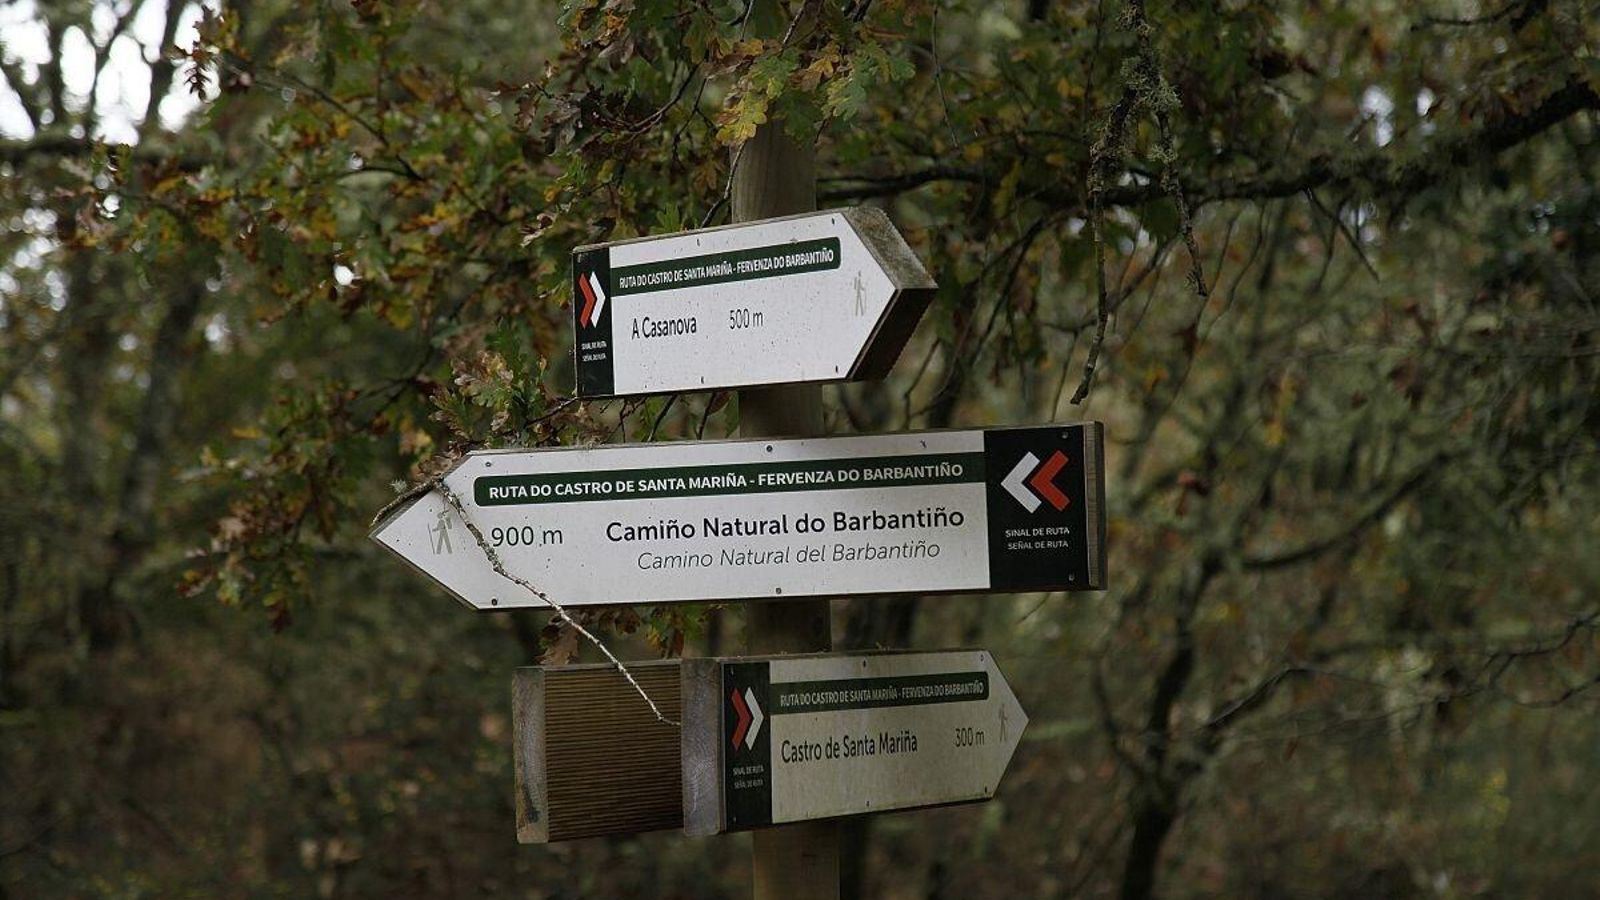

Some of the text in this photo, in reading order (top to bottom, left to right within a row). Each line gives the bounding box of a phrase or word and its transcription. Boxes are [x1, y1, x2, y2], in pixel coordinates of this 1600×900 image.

[619, 276, 637, 289] RUTA
[637, 272, 647, 286] DO
[647, 270, 673, 285] CASTRO
[674, 266, 683, 281] DE
[683, 264, 705, 280] SANTA
[706, 261, 732, 277] MARIÑA
[736, 258, 773, 273] FERVENZA
[773, 254, 785, 269] DO
[785, 247, 833, 267] BARBANTIÑO
[631, 316, 697, 339] A Casanova
[729, 309, 764, 329] 500 m
[489, 485, 528, 499] RUTA
[530, 484, 552, 497] DO
[554, 480, 612, 496] CASTRO
[615, 478, 635, 493] DE
[637, 477, 686, 492] SANTA
[688, 472, 748, 489] MARIÑA
[758, 471, 835, 486] FERVENZA
[837, 469, 860, 482] DO
[863, 462, 964, 481] BARBANTIÑO
[491, 526, 564, 547] 900 m
[606, 507, 966, 542] Camiño Natural do Barbantiño
[1005, 527, 1070, 538] SINAL DE RUTA
[637, 540, 941, 570] Camino Natural del Barbantiño
[1034, 541, 1046, 549] DE
[1047, 540, 1069, 549] RUTA
[780, 693, 799, 707] RUTA
[800, 692, 811, 705] DO
[811, 690, 840, 706] CASTRO
[840, 689, 849, 703] DE
[850, 688, 872, 702] SANTA
[873, 684, 898, 701] MARIÑA
[901, 684, 934, 698] FERVENZA
[935, 684, 944, 697] DO
[945, 679, 984, 695] BARBANTIÑO
[781, 728, 918, 763] Castro de Santa Mariña
[955, 727, 985, 747] 300 m
